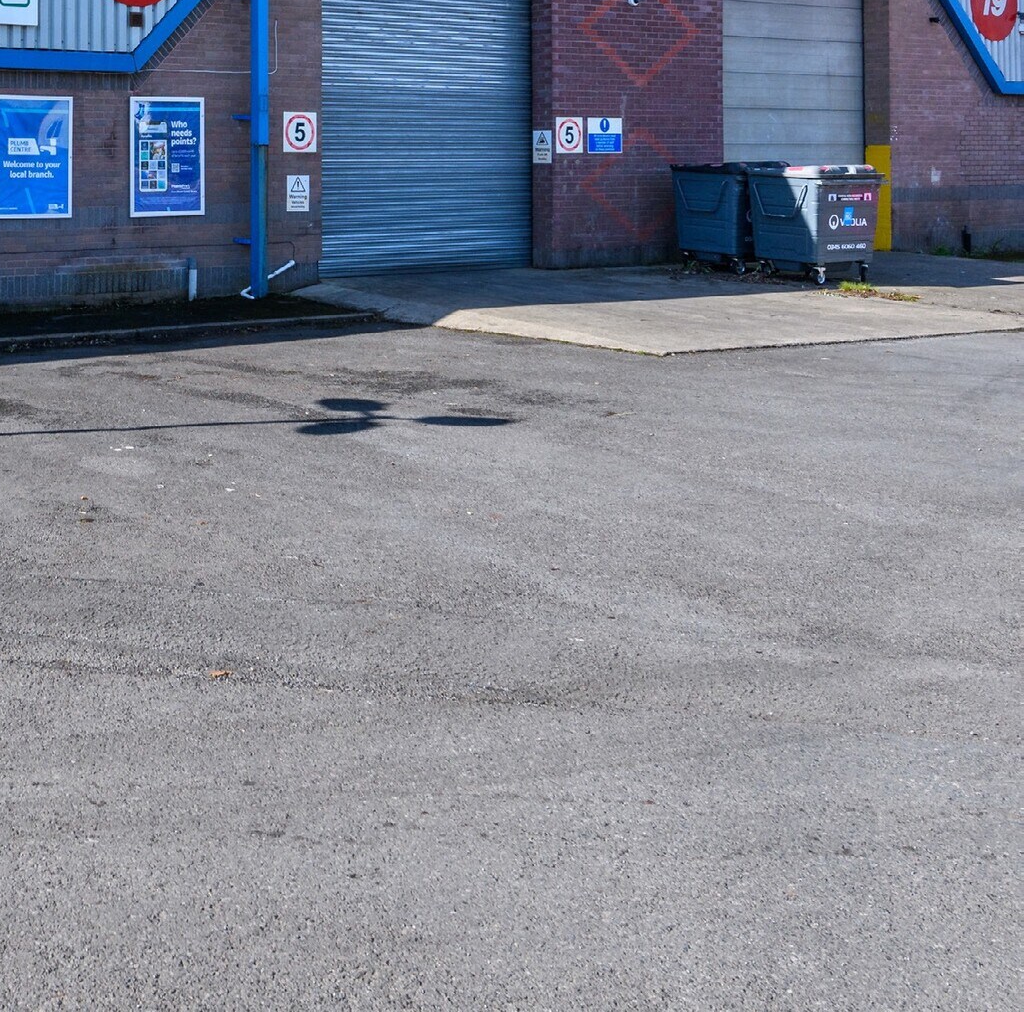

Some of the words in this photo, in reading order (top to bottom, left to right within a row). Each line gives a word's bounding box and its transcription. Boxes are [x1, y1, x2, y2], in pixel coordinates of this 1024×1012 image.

[171, 120, 187, 128] Who
[171, 129, 192, 137] needs
[295, 122, 305, 142] 5
[565, 126, 574, 144] 5
[171, 137, 196, 147] points?
[3, 160, 35, 168] Welcome
[36, 160, 43, 168] to
[44, 162, 61, 170] your
[9, 170, 27, 178] local
[28, 170, 54, 178] branch.
